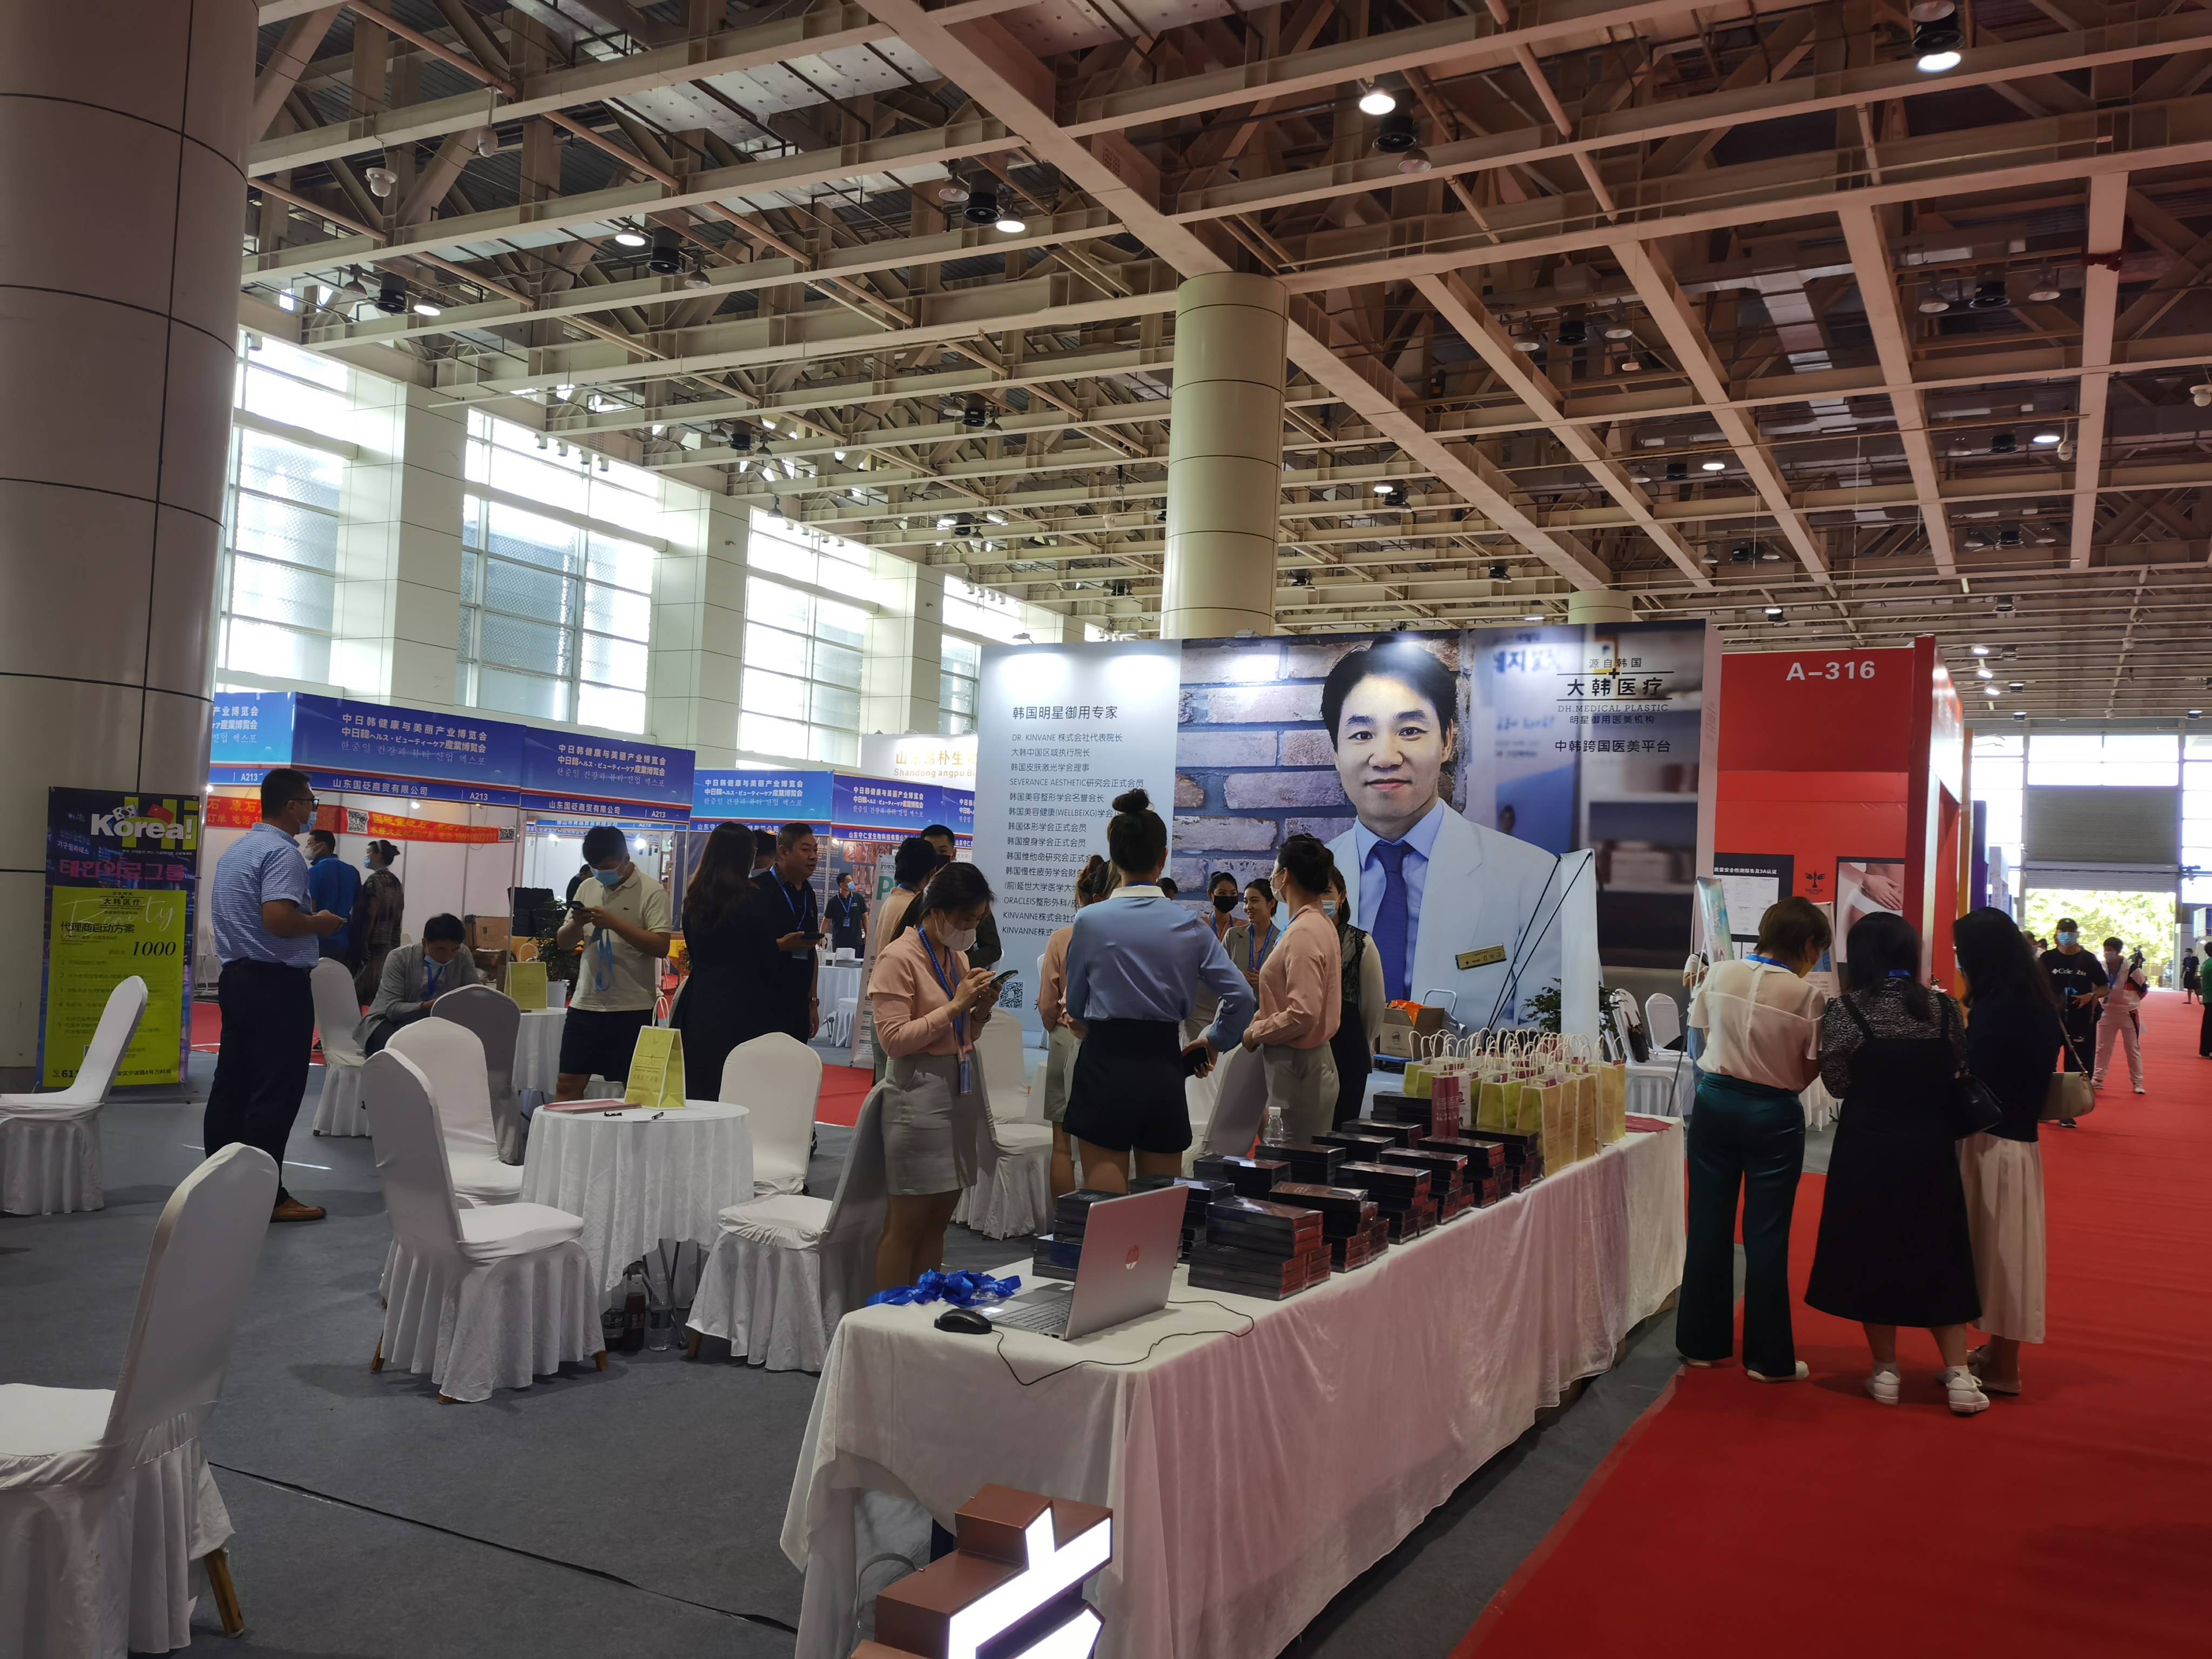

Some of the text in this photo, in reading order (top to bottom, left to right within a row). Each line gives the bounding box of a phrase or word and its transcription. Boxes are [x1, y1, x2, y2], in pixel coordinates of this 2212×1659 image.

[1589, 658, 1642, 669] 源自韩国
[1786, 660, 1875, 680] A-316
[1567, 677, 1663, 697] 大韩医疗
[1013, 706, 1118, 719] 韩国明星御用专家
[1569, 716, 1655, 724] 明星御用医美机构
[342, 713, 487, 741] 中日韩健康与美丽产业博览会
[1058, 733, 1123, 742] 株式会社代表院长
[341, 741, 370, 752] 한중일
[1555, 740, 1671, 752] 中韩跨国医美平台
[558, 744, 666, 765] 中日韩健康与美丽产业博览会
[1011, 748, 1090, 757] 大韩中国区域执行院长
[894, 768, 936, 778] Shandong
[938, 770, 964, 778] angpu
[1011, 763, 1089, 772] 韩国皮肤激光学会理事
[241, 773, 258, 781] A213
[333, 779, 428, 795] 山东国砭商贸有限公司
[705, 779, 804, 788] 中日韩健康与美丽产业博览会
[1050, 779, 1144, 788] AESTHETIC研究会正式会员
[1009, 792, 1104, 802] 韩国美容整形学会名誉会长
[549, 800, 621, 814] 山东国砭商贸有限公司
[91, 813, 193, 840] Korea!
[1008, 822, 1087, 833] 韩国体形学会正式会员
[1007, 837, 1086, 848] 韩国瘦身学会正式会员
[60, 922, 134, 933] 代理商启动方案
[1002, 927, 1058, 936] KINVANNE株式
[132, 941, 177, 956] 1000
[2058, 968, 2087, 976] Colbia
